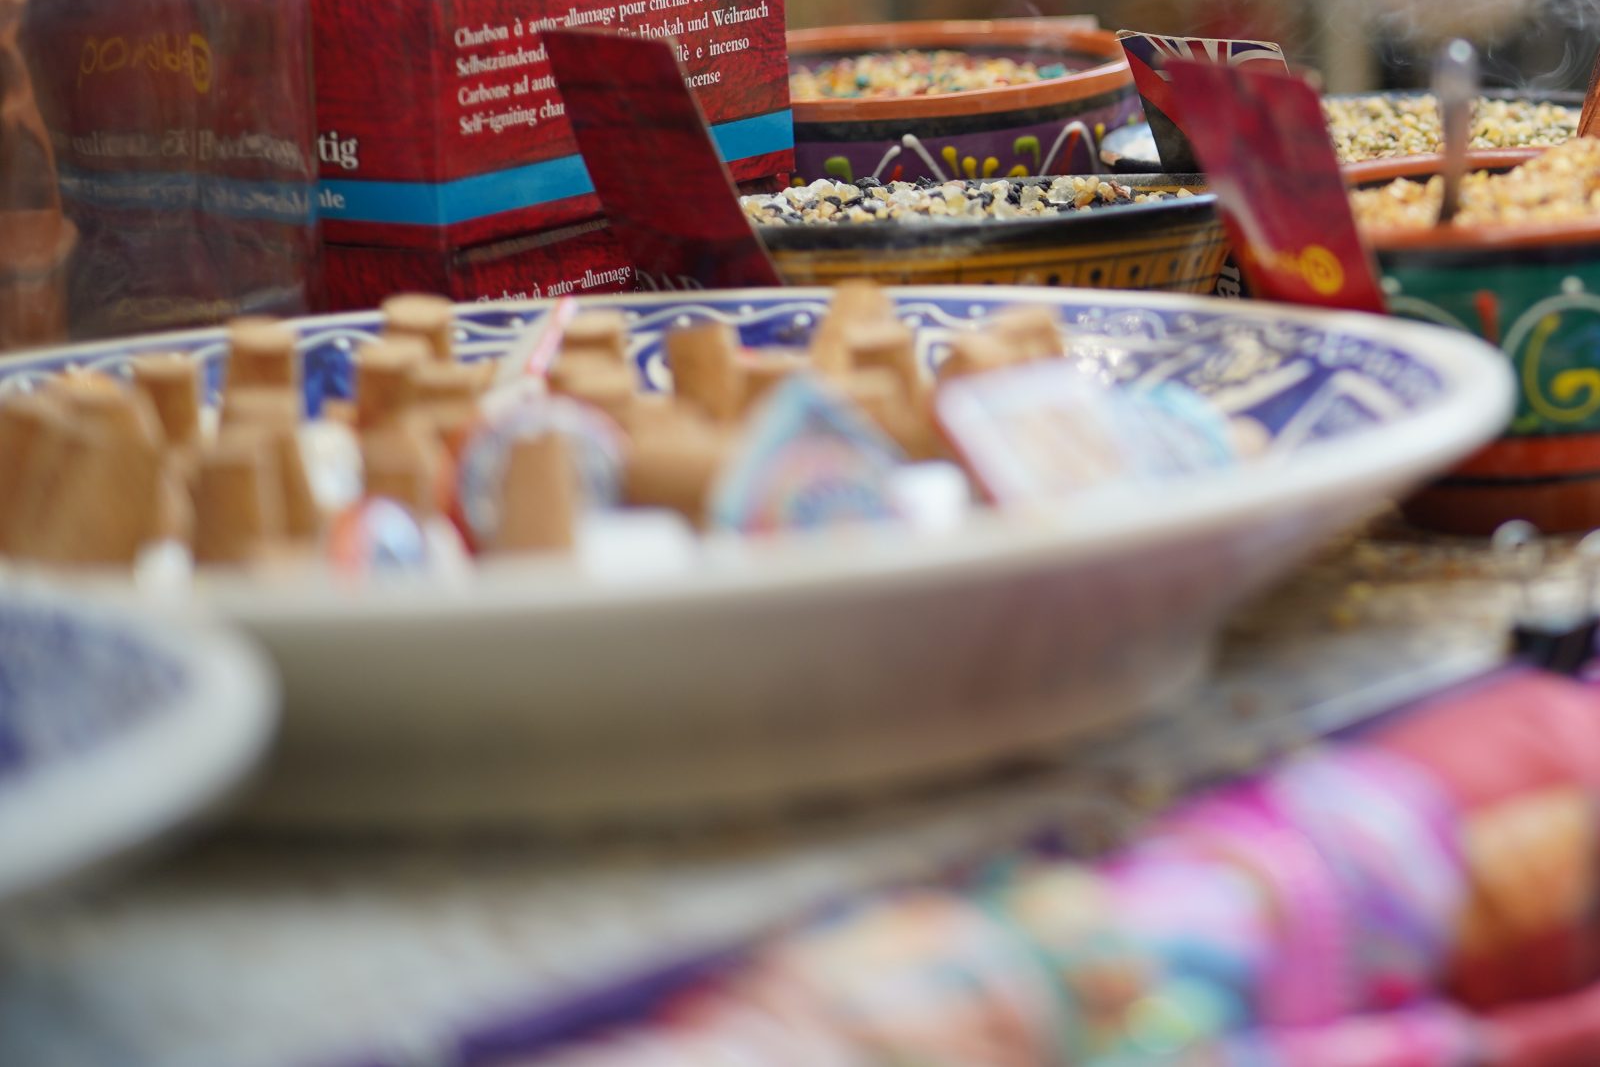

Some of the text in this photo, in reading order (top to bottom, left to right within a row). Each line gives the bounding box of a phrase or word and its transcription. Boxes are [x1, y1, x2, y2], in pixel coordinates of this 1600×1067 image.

[513, 16, 524, 37] à
[529, 7, 616, 34] auto-allumage
[619, 0, 646, 22] pour
[639, 16, 684, 39] Hookah
[687, 11, 709, 32] und
[711, 0, 769, 27] Weihrauch
[458, 82, 511, 106] Carbone
[513, 74, 529, 95] ad
[696, 46, 703, 59] e
[709, 37, 749, 56] incenso
[460, 104, 537, 134] Self-igniting
[547, 265, 631, 297] auto-allumage
